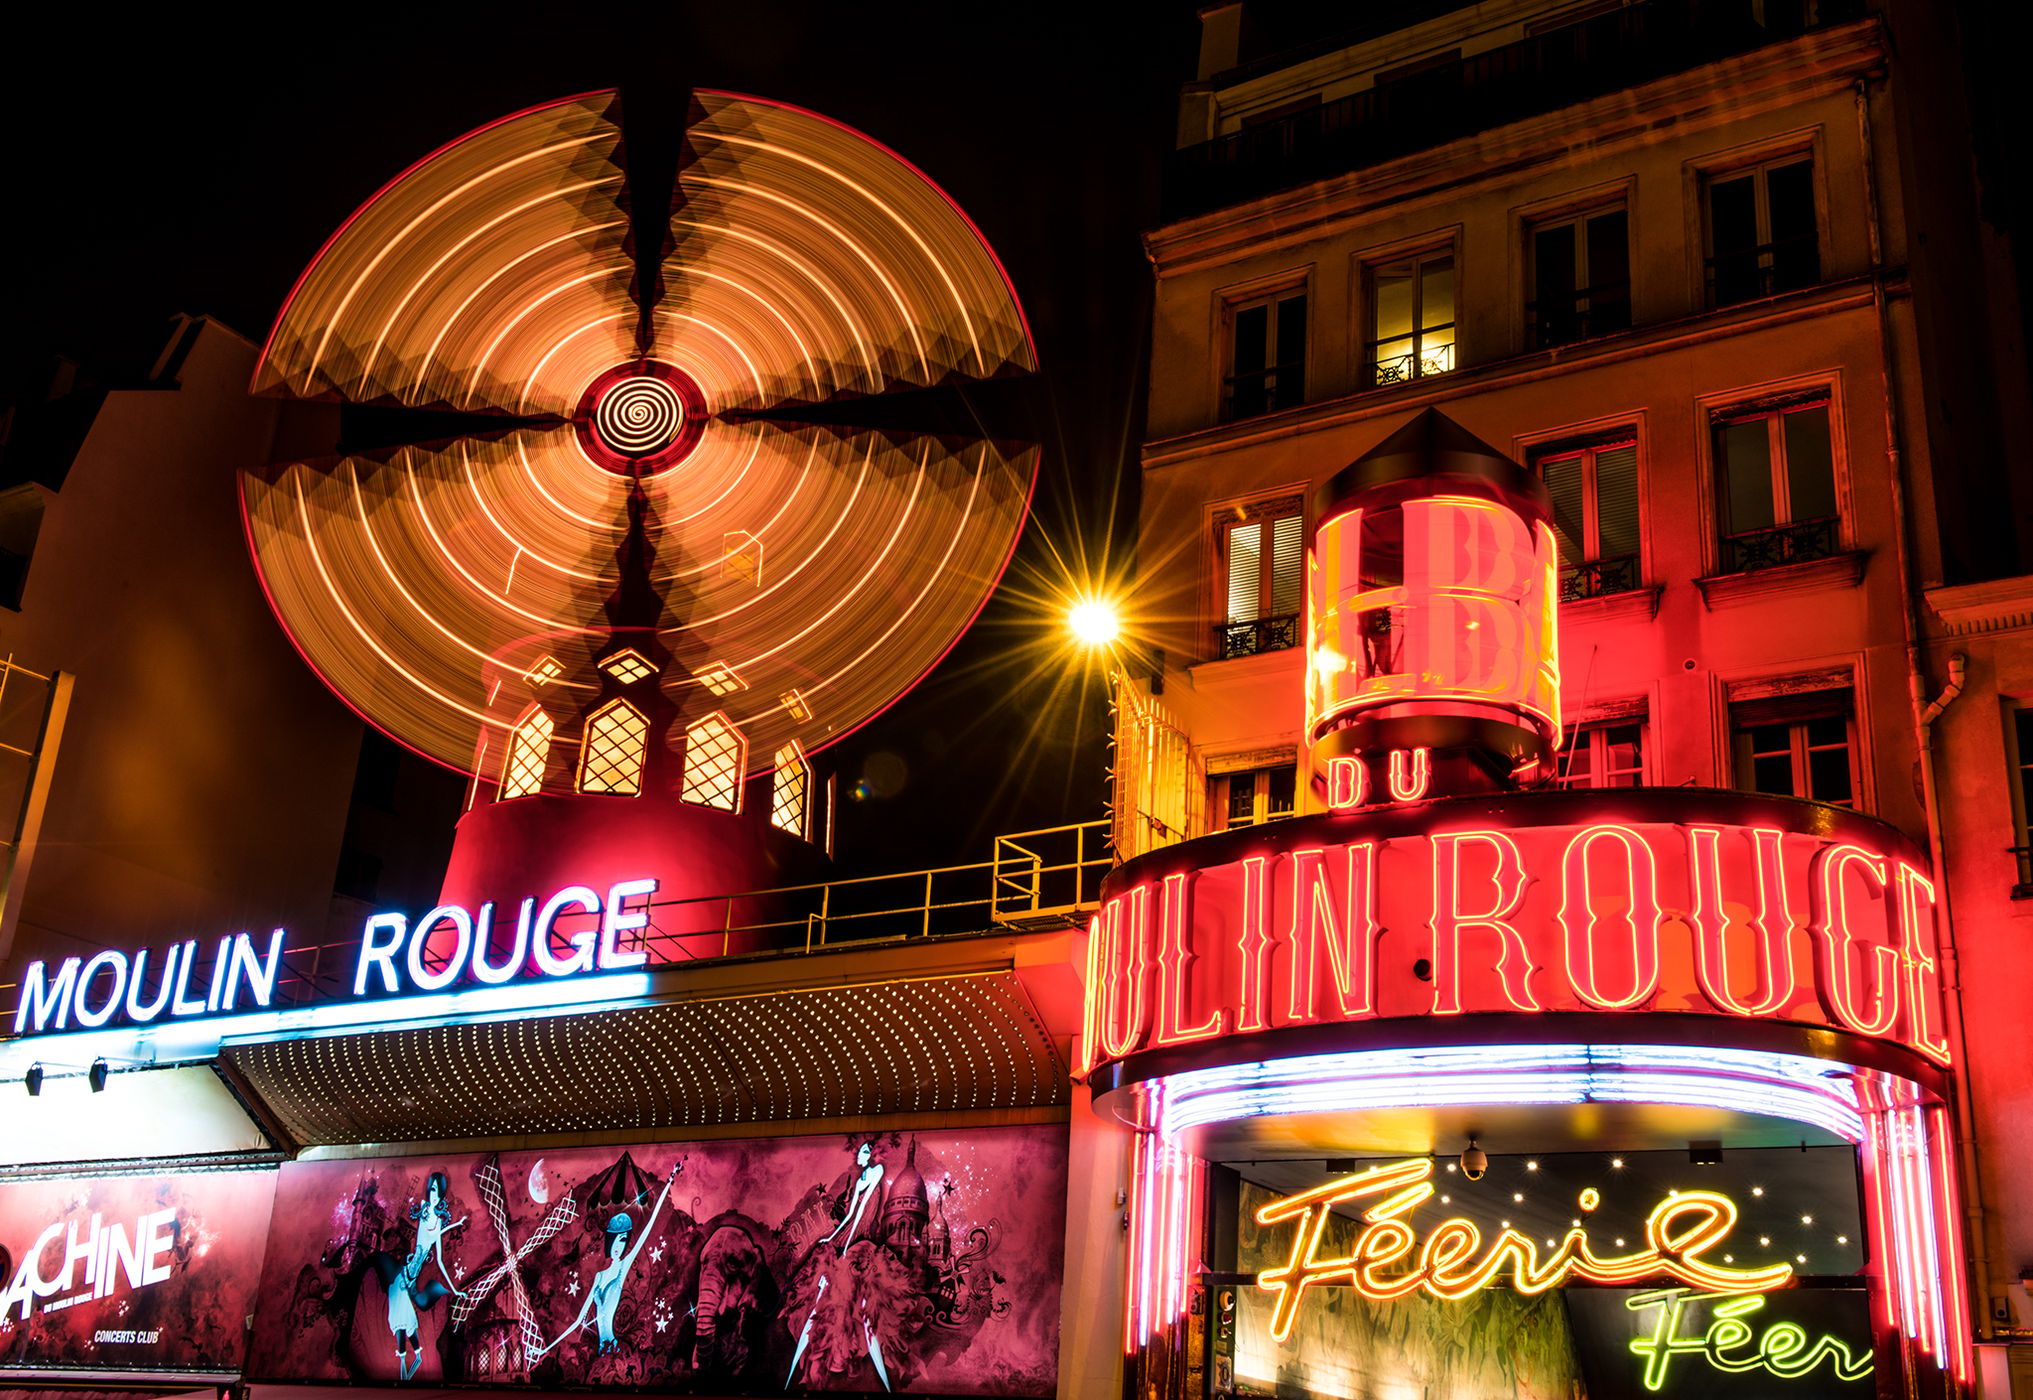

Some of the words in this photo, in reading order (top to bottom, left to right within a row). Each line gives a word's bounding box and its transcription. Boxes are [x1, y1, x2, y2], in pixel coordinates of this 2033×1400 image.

[1327, 747, 1426, 809] DU
[15, 927, 287, 1034] MOULIN
[353, 878, 660, 996] ROUGE
[1429, 823, 1952, 1065] ROUGE
[1255, 1157, 1794, 1343] Féerie
[94, 1329, 136, 1343] CONCERTS
[136, 1330, 159, 1344] CLUB
[1625, 1288, 1875, 1391] Féer
